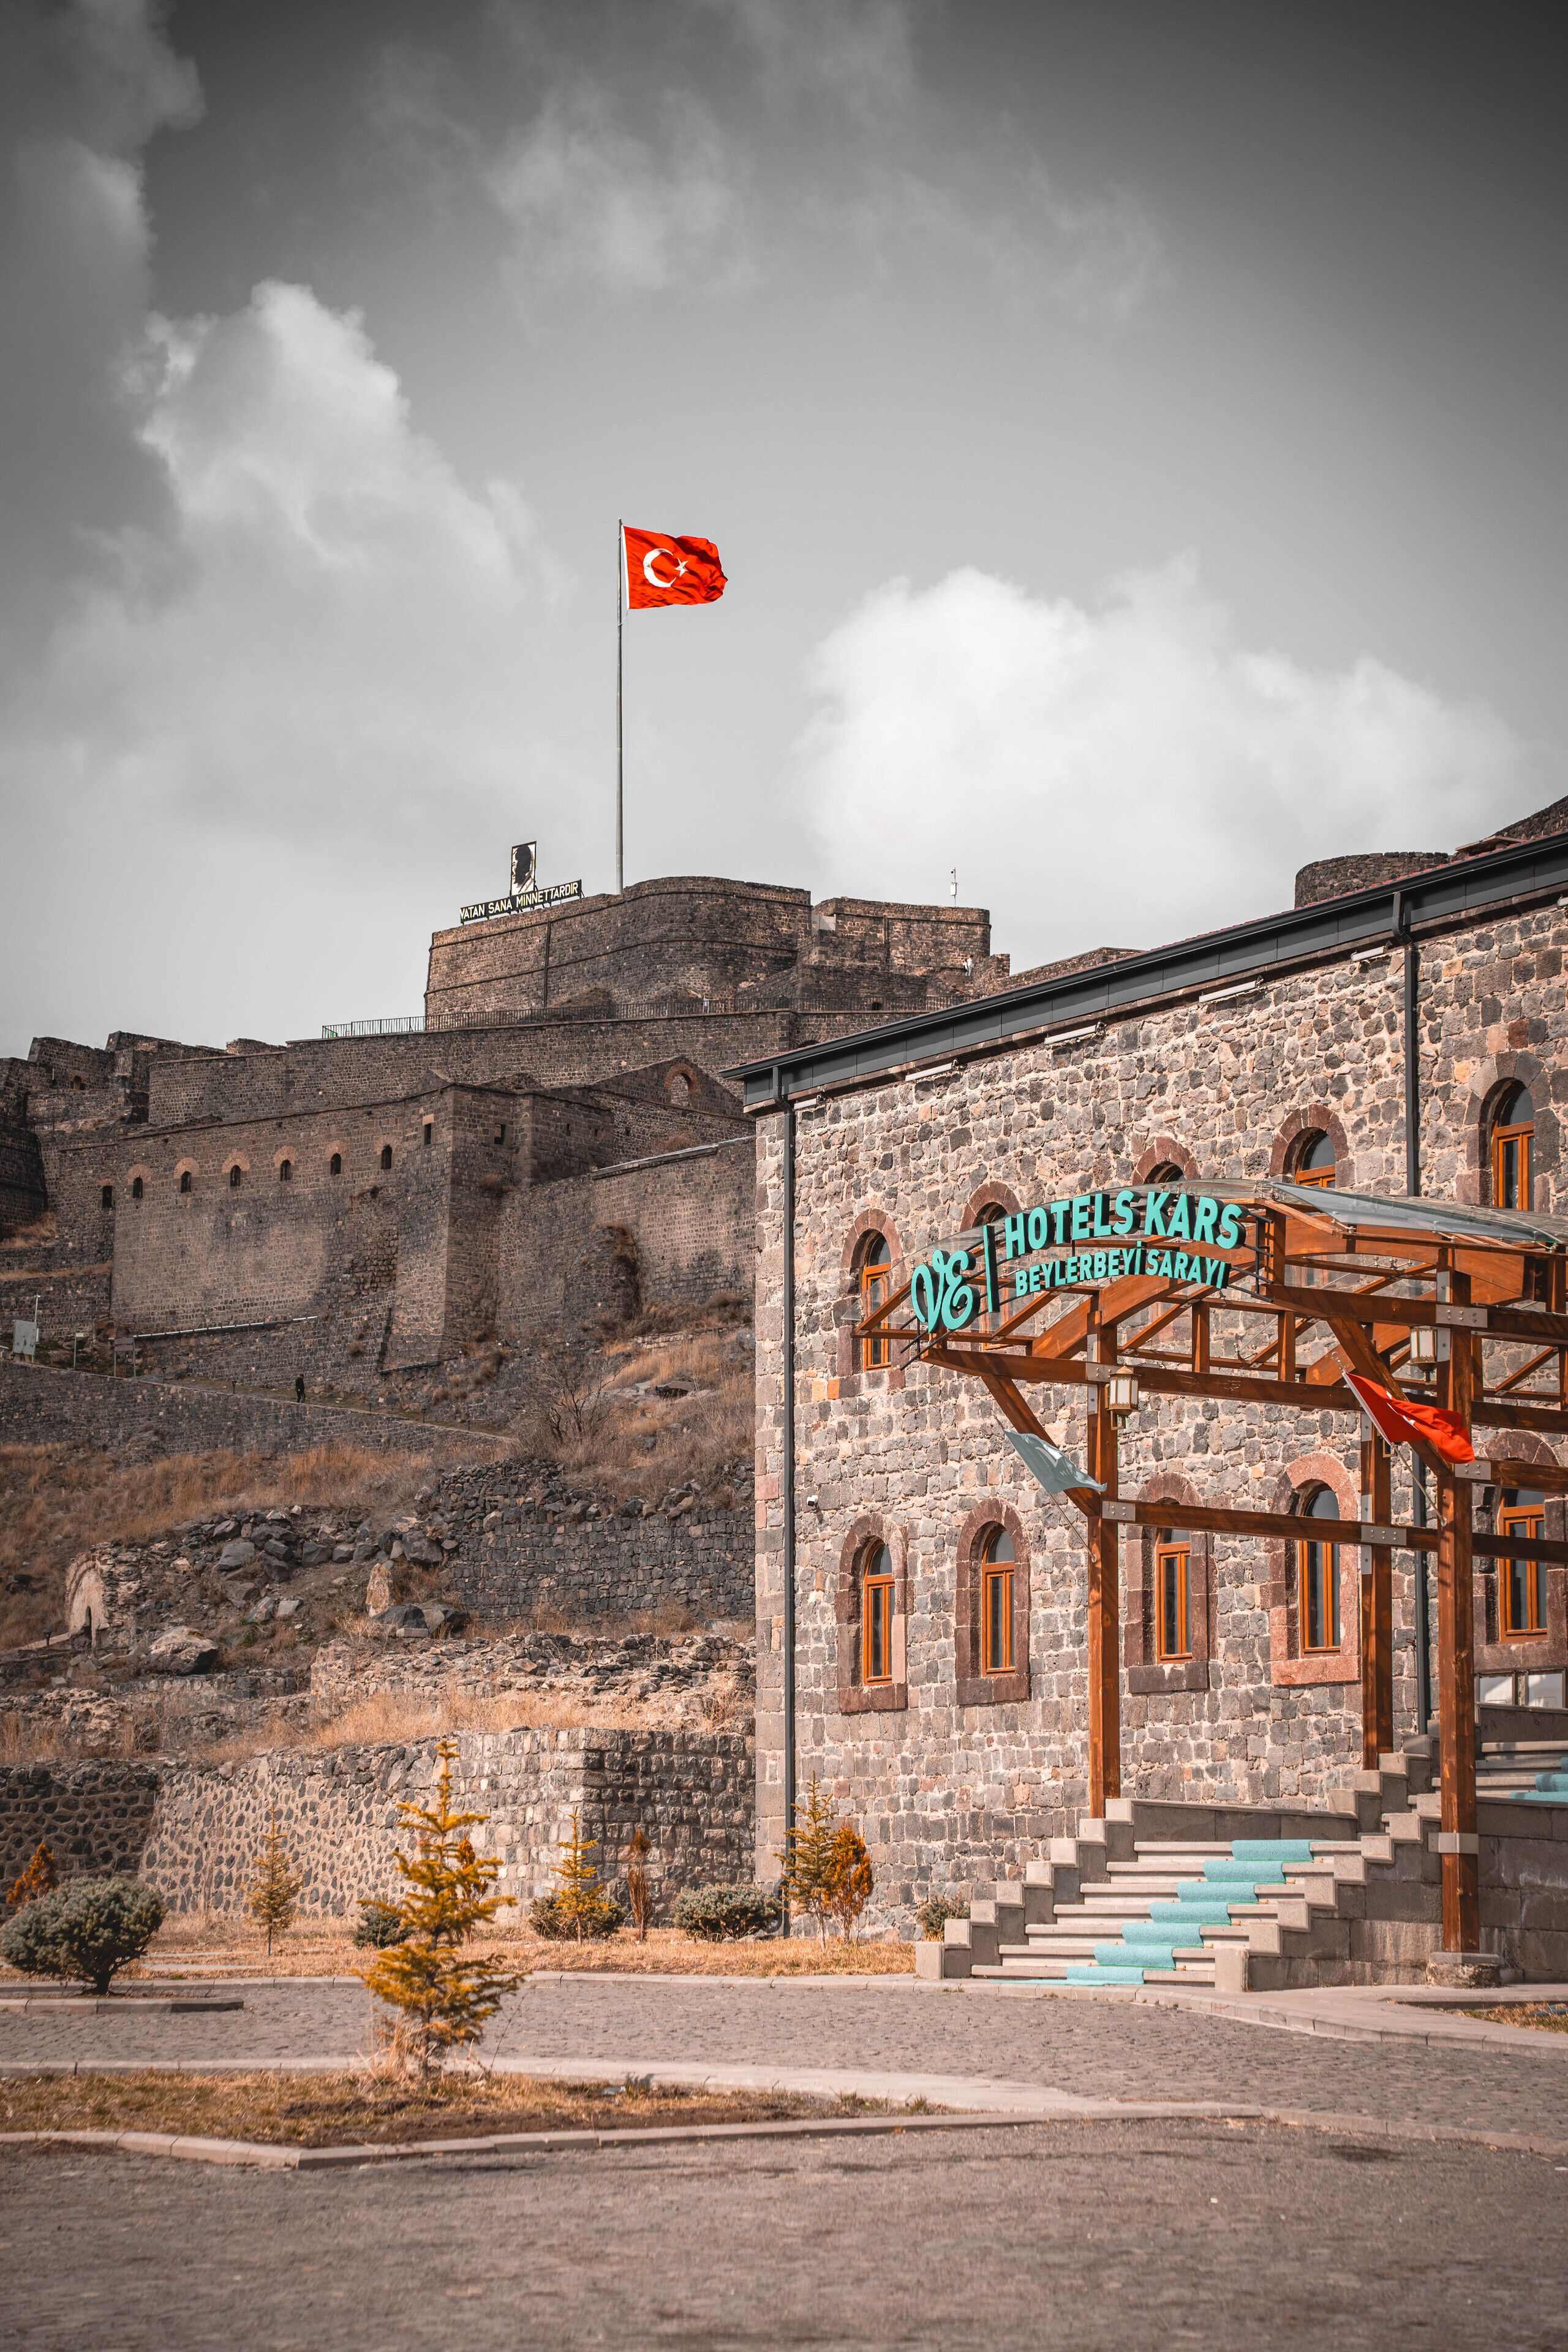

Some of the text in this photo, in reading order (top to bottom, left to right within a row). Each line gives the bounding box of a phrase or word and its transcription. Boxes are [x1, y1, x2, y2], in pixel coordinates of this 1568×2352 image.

[460, 882, 579, 919] VATAN SANA MİNNETTARDIR
[1005, 1190, 1243, 1259] HOTELS KARS
[1016, 1242, 1227, 1296] BEYLERBEYİ SARAYI
